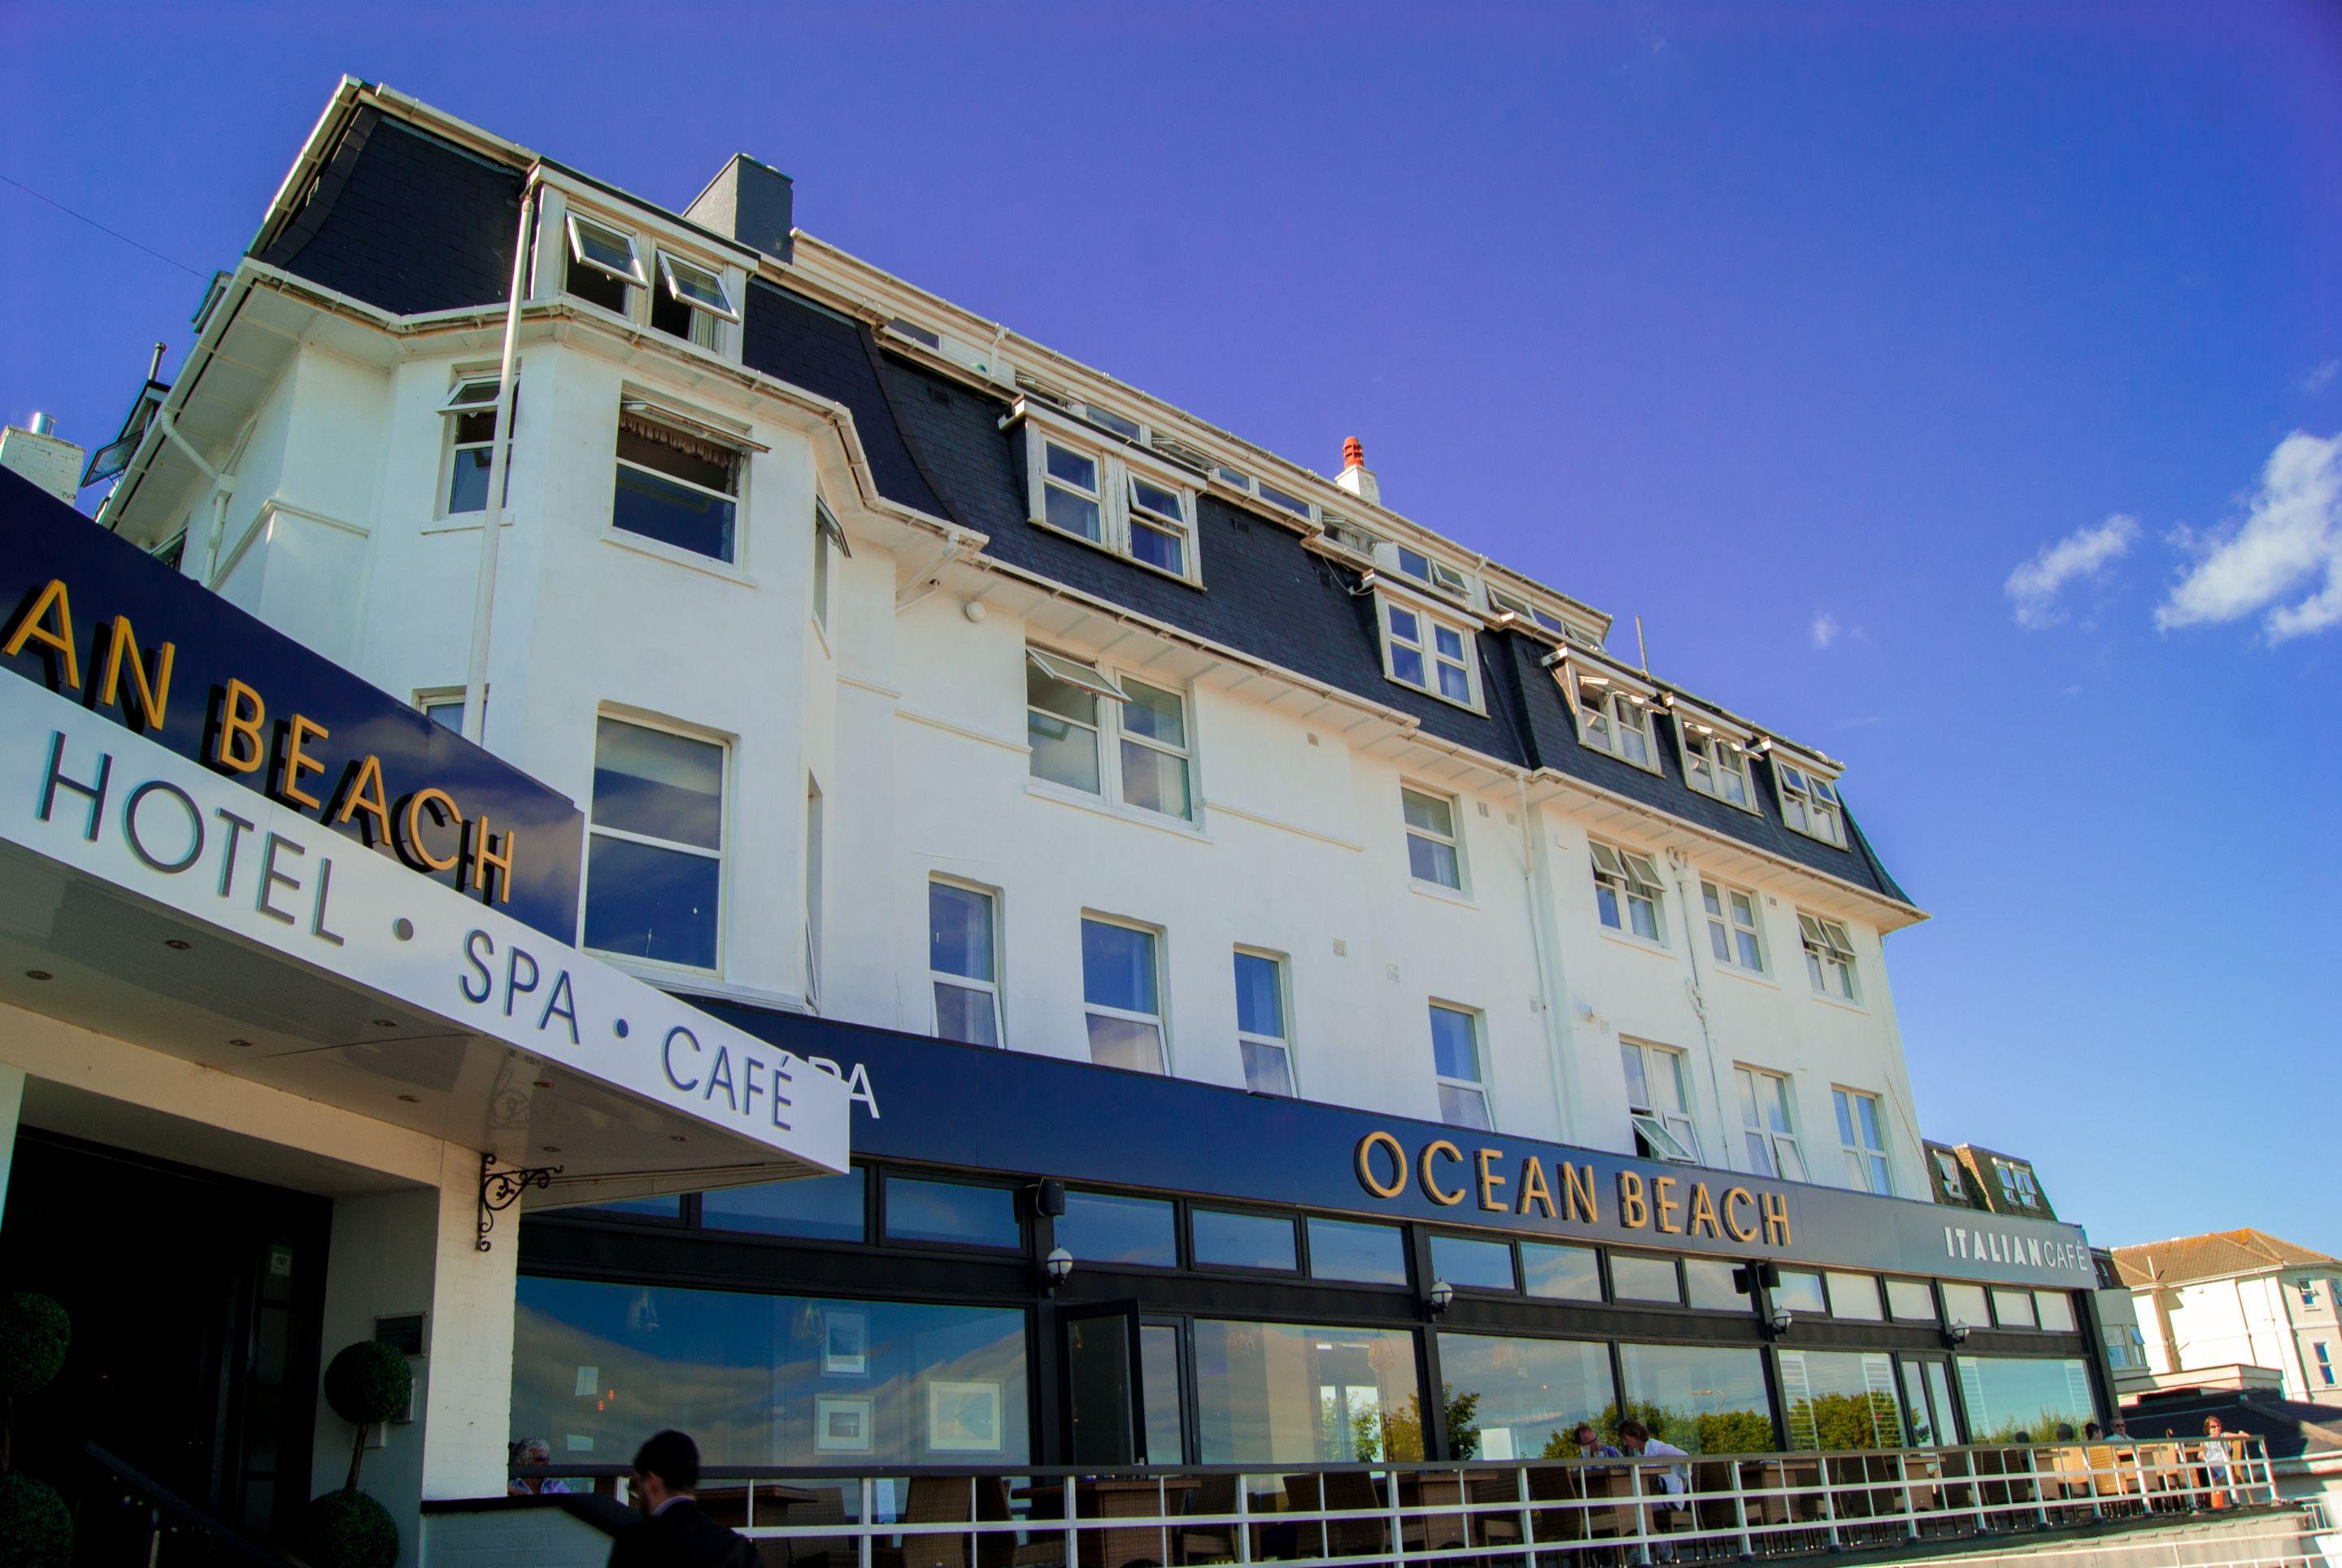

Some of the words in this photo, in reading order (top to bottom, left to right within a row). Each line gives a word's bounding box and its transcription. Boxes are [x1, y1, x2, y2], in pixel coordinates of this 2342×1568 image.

[218, 677, 515, 904] BEACH
[37, 730, 345, 947] HOTEL
[458, 929, 580, 1046] SPA
[661, 1026, 792, 1131] CAFÉ
[1360, 1130, 1598, 1223] OCEAN
[1622, 1169, 1791, 1246] BEACH
